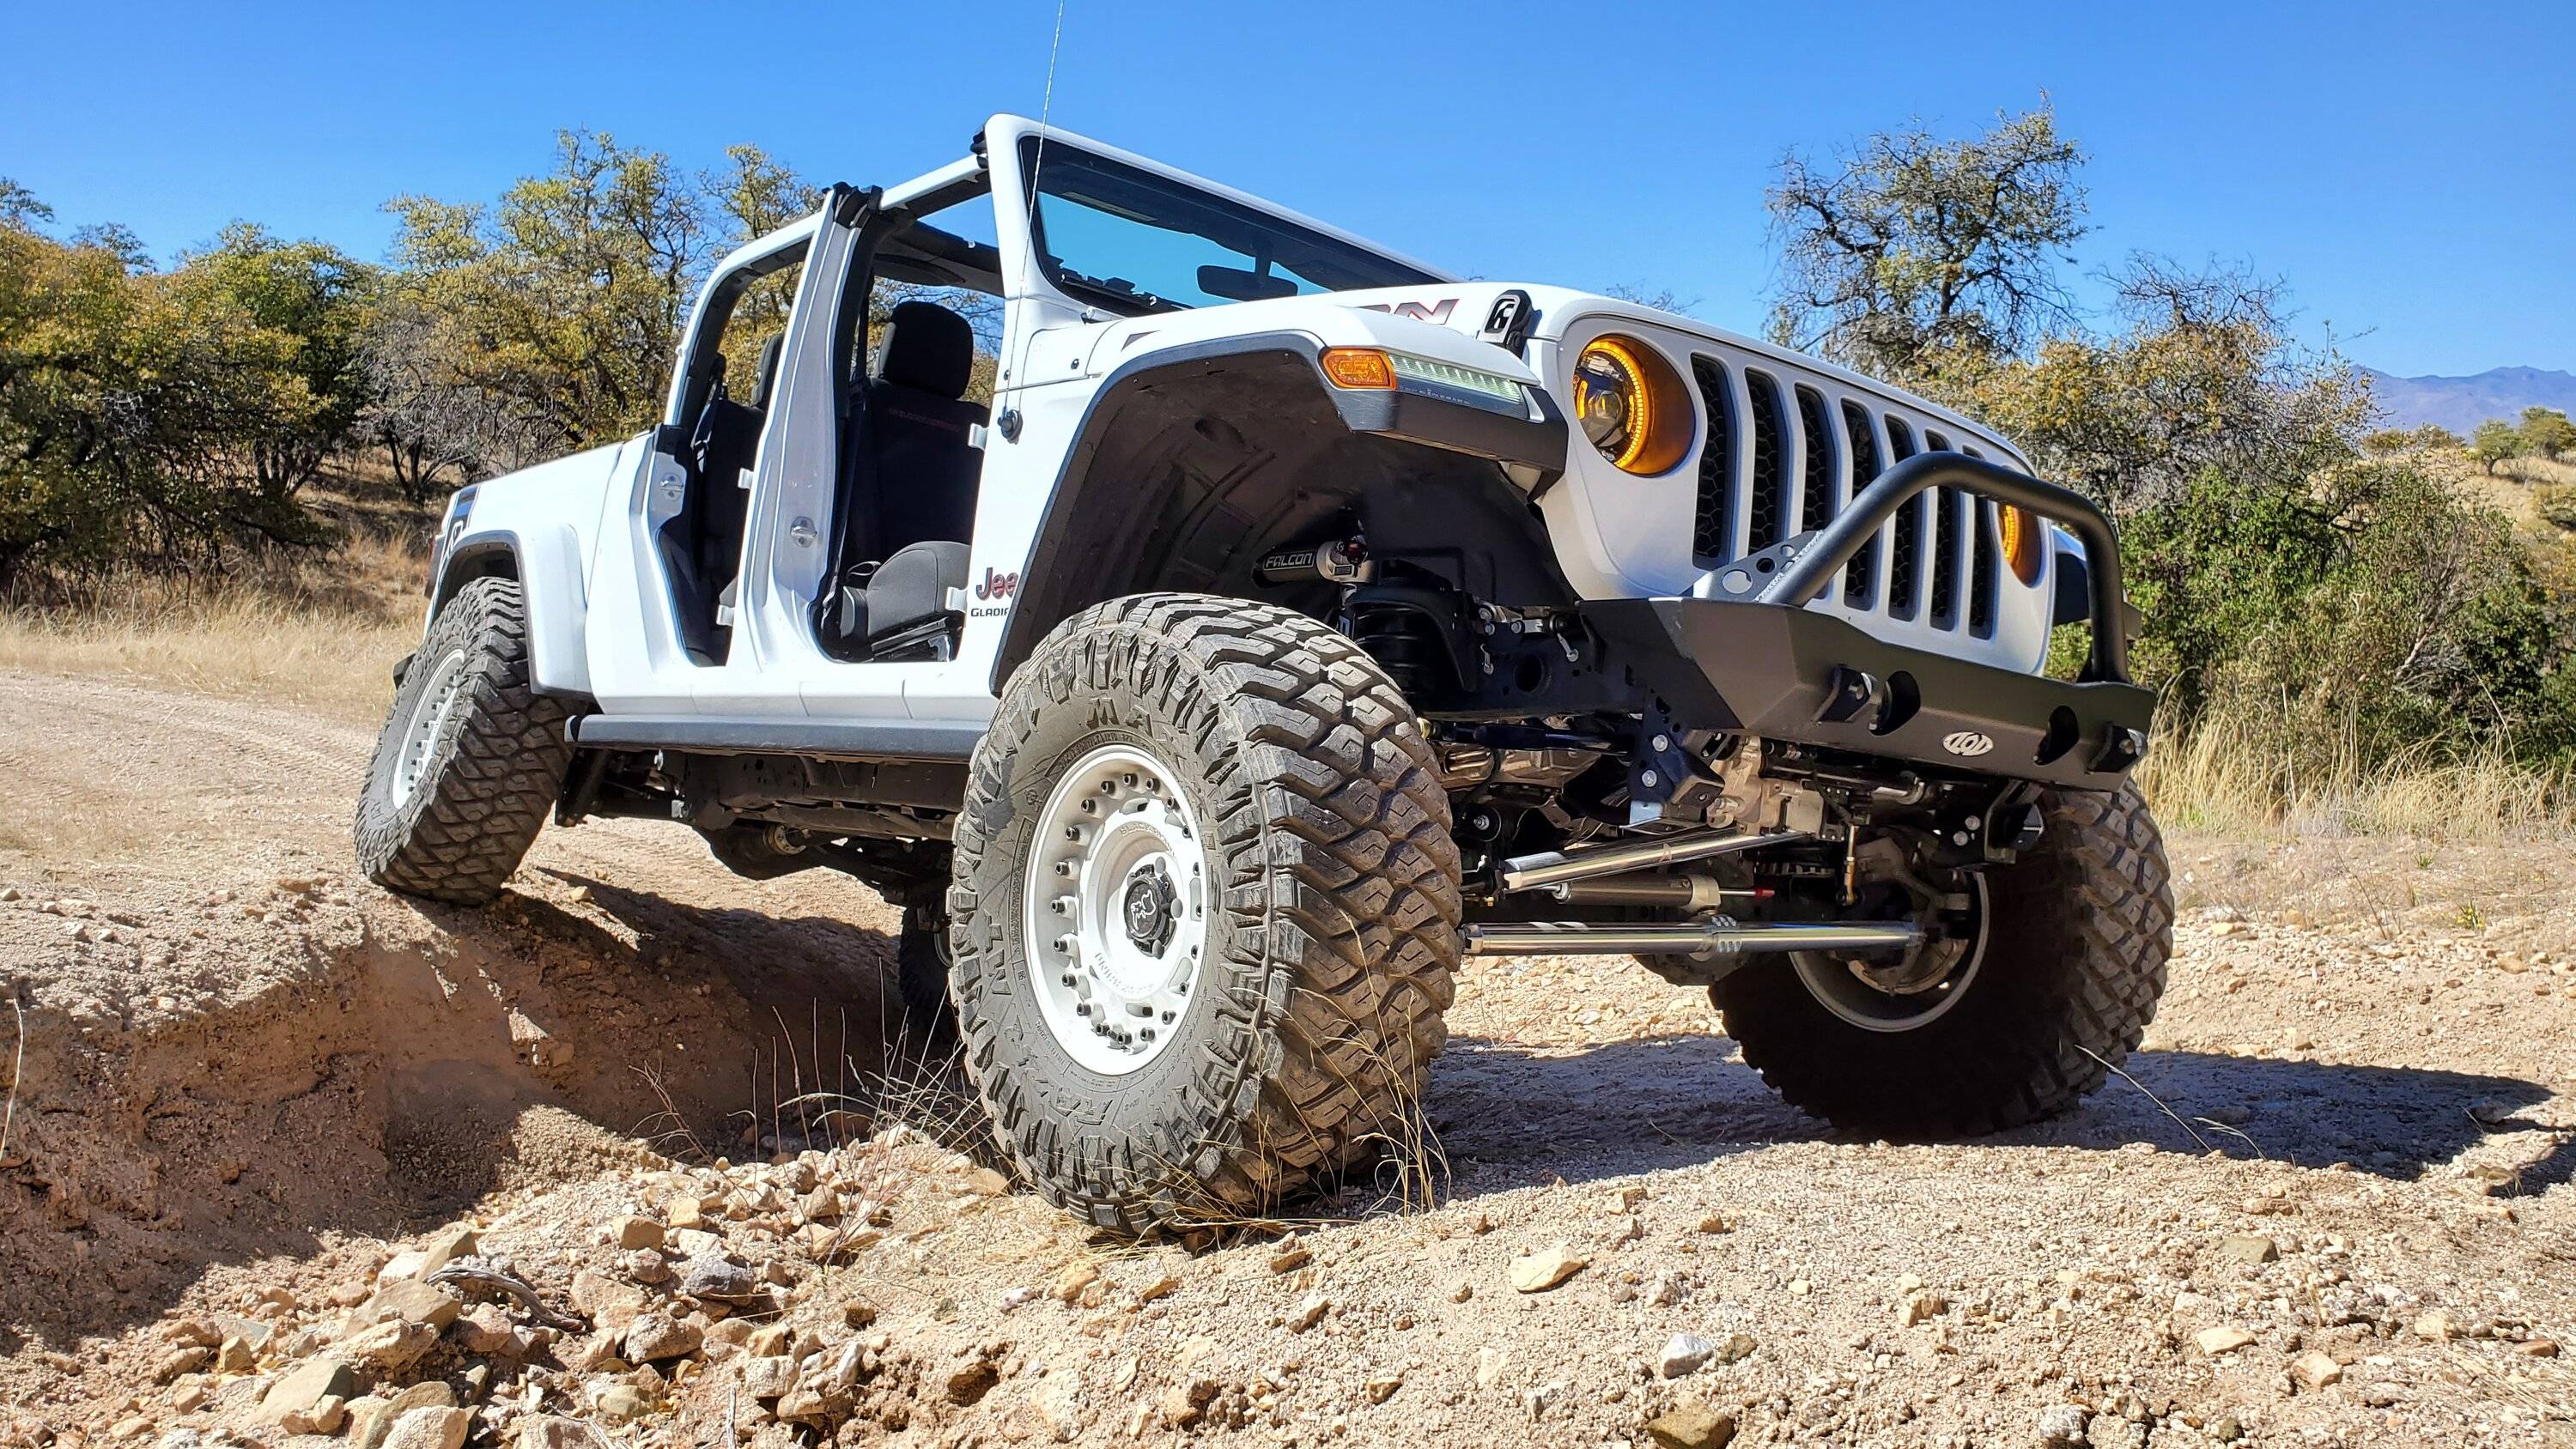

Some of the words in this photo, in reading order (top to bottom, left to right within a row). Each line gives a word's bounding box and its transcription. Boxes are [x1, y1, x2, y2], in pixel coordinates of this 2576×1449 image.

[1266, 553, 1313, 567] FALCON
[975, 567, 1018, 601] Jee
[970, 608, 1009, 616] GLADI
